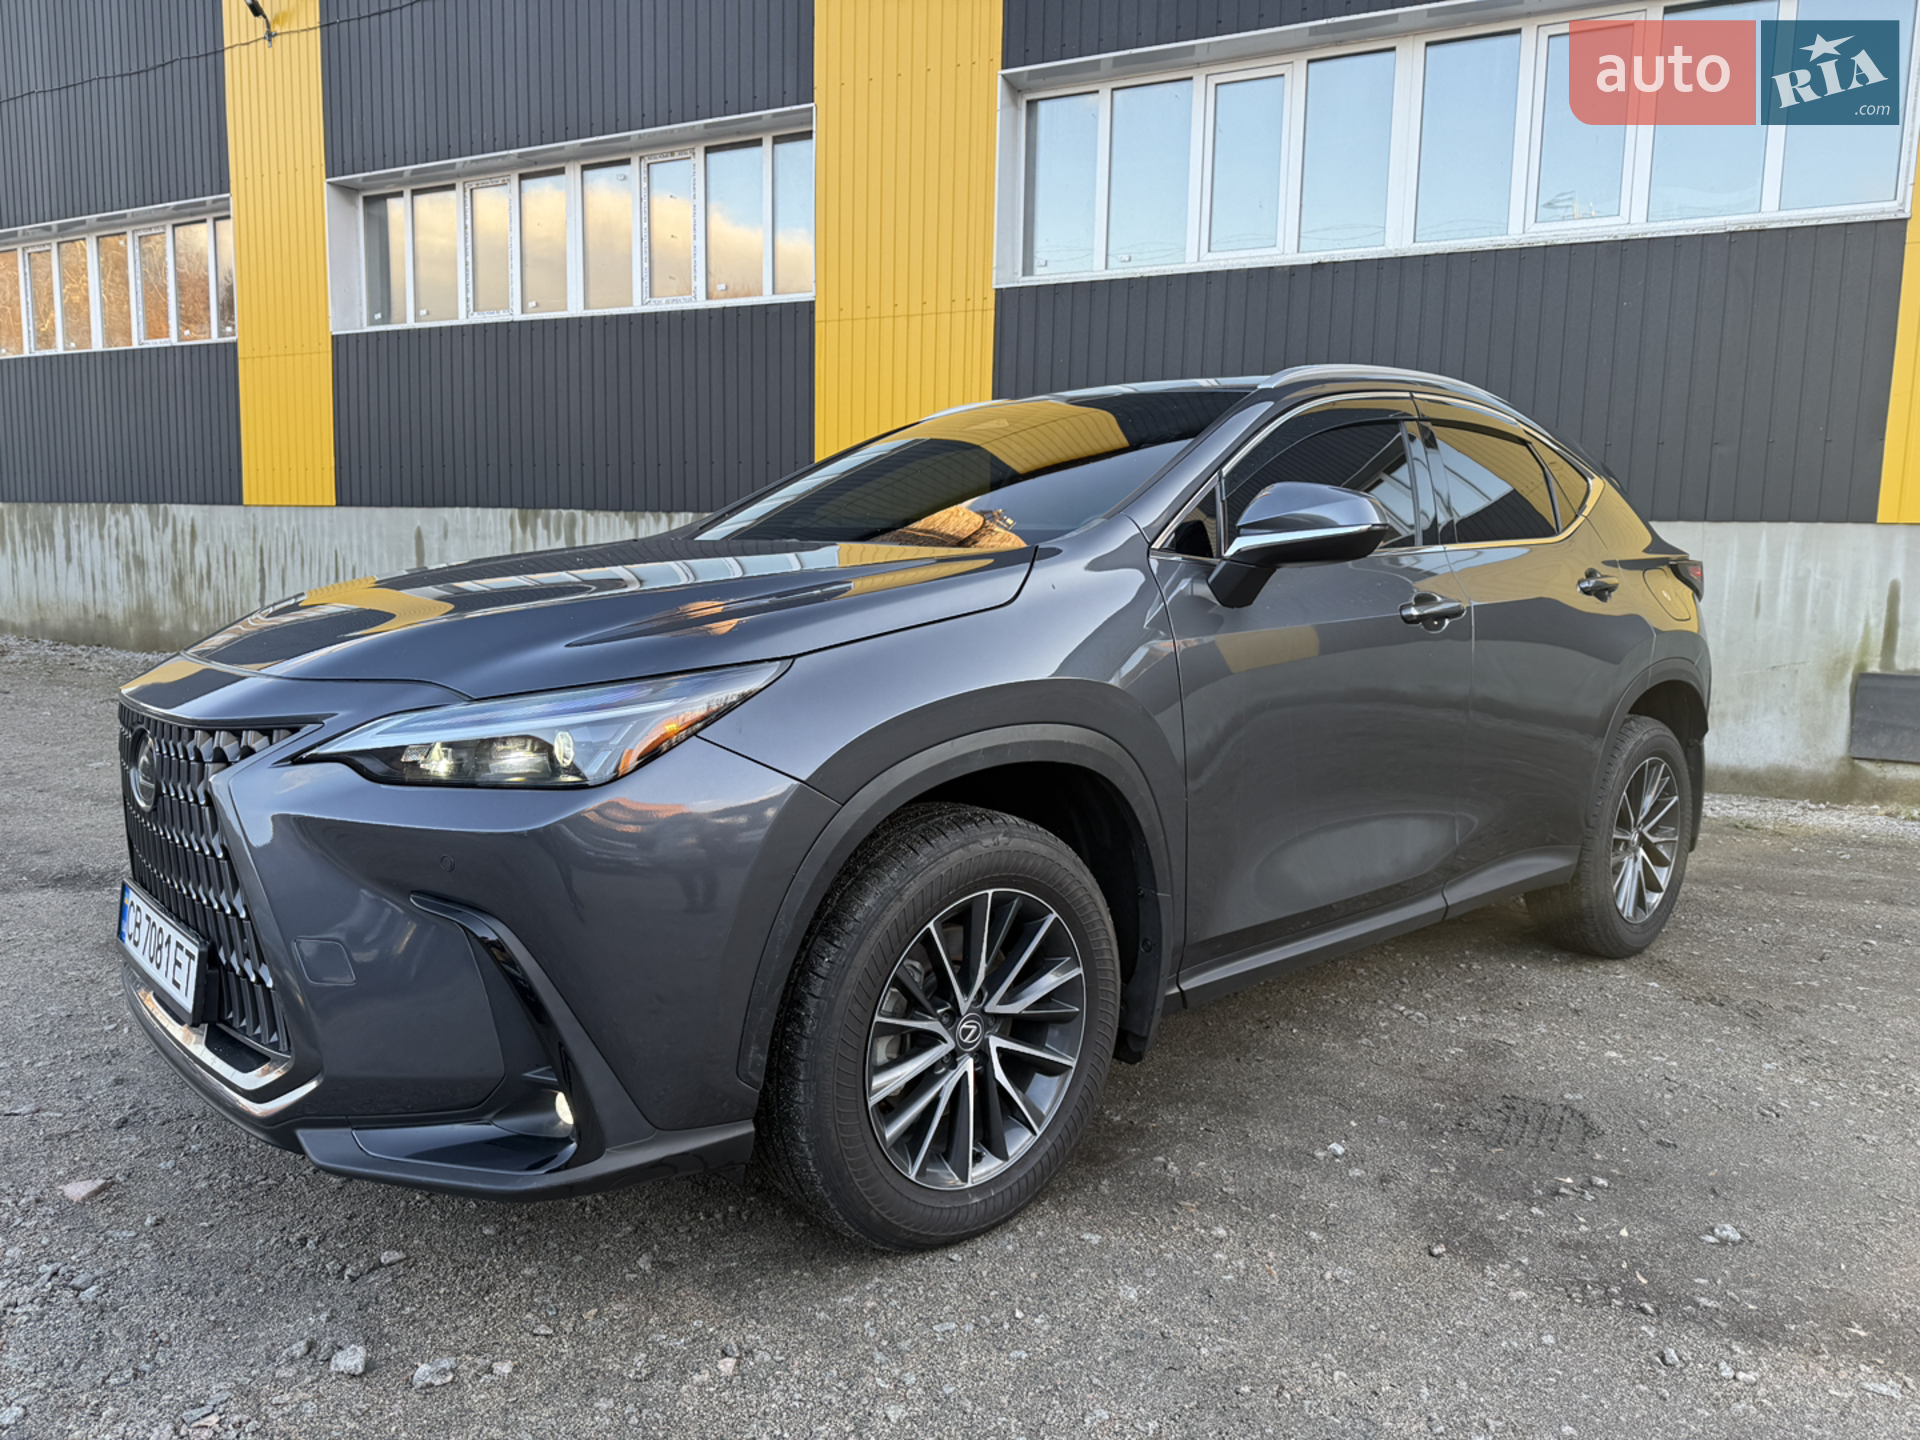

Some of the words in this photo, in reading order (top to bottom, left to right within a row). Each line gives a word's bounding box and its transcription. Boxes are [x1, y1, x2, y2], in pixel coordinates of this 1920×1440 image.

[127, 900, 142, 948] CB
[142, 914, 172, 979] 7081
[172, 940, 196, 998] ET
